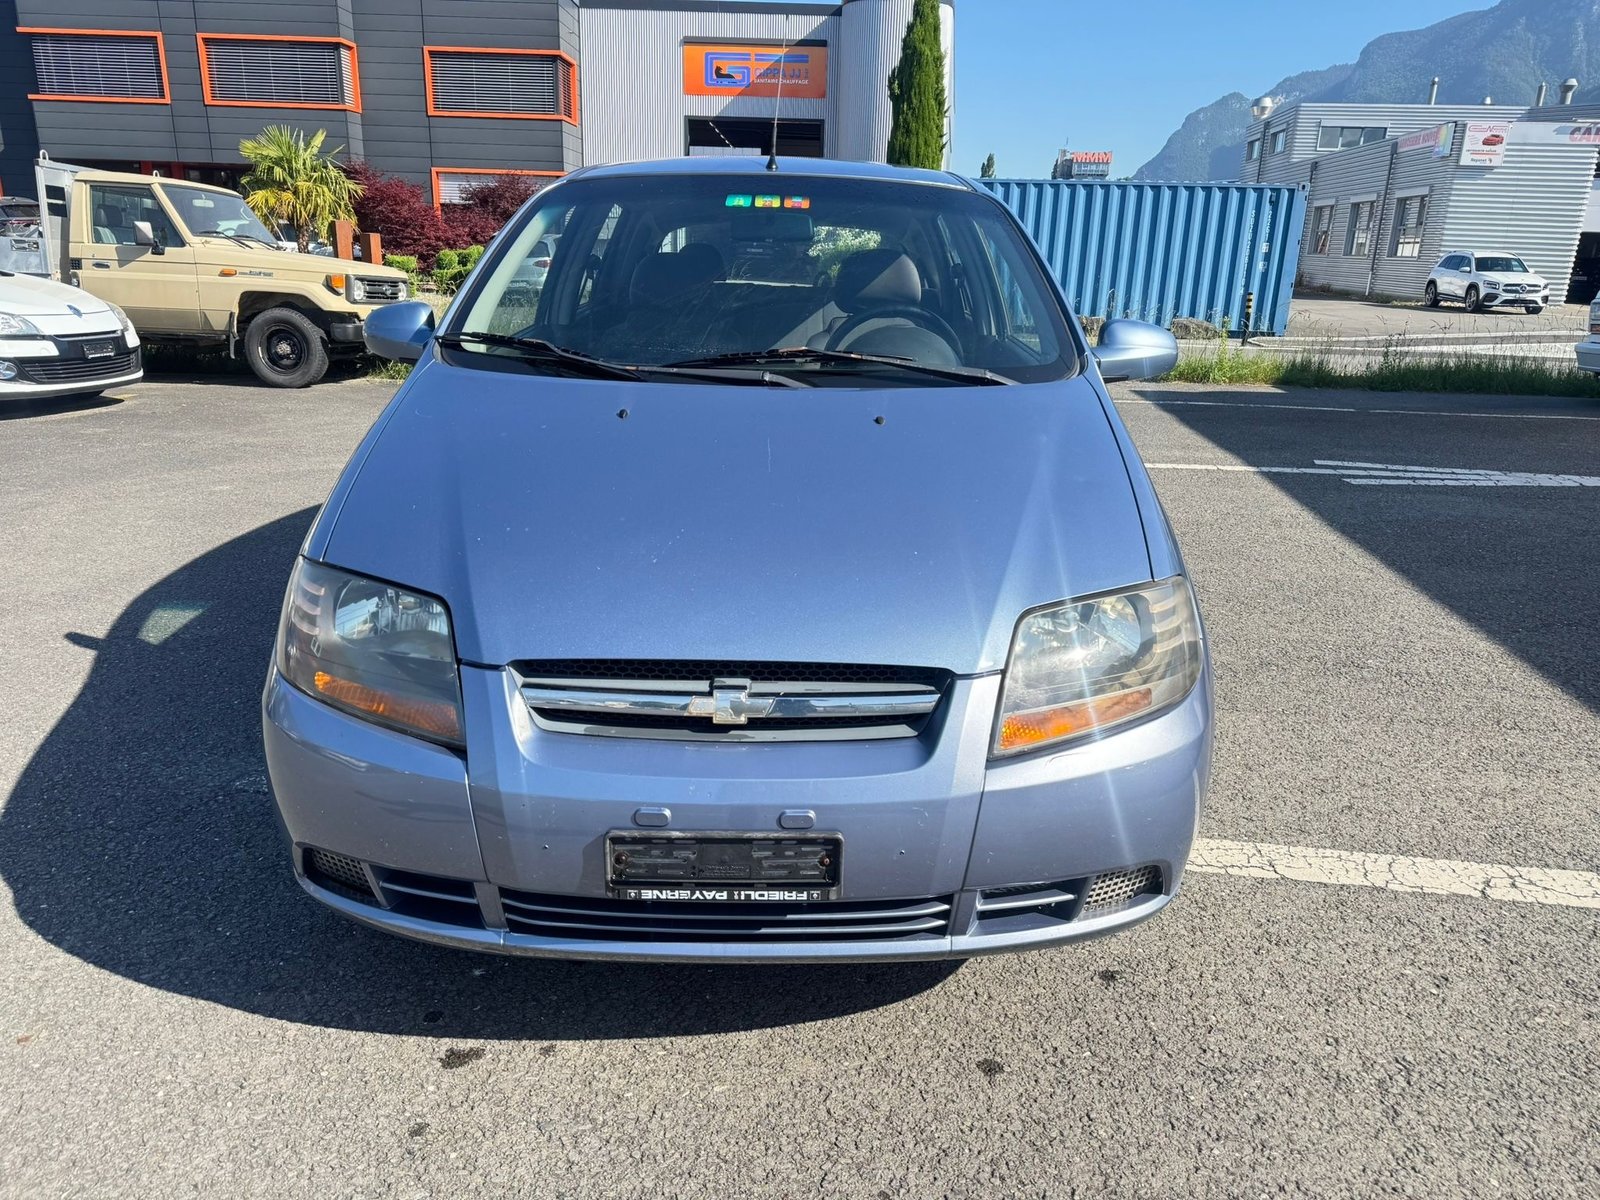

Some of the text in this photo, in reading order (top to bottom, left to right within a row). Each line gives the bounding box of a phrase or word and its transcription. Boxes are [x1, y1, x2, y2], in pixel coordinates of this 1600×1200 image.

[1072, 152, 1112, 163] MMM
[641, 889, 728, 900] PAYERNE
[740, 890, 808, 900] FRIEDLI
